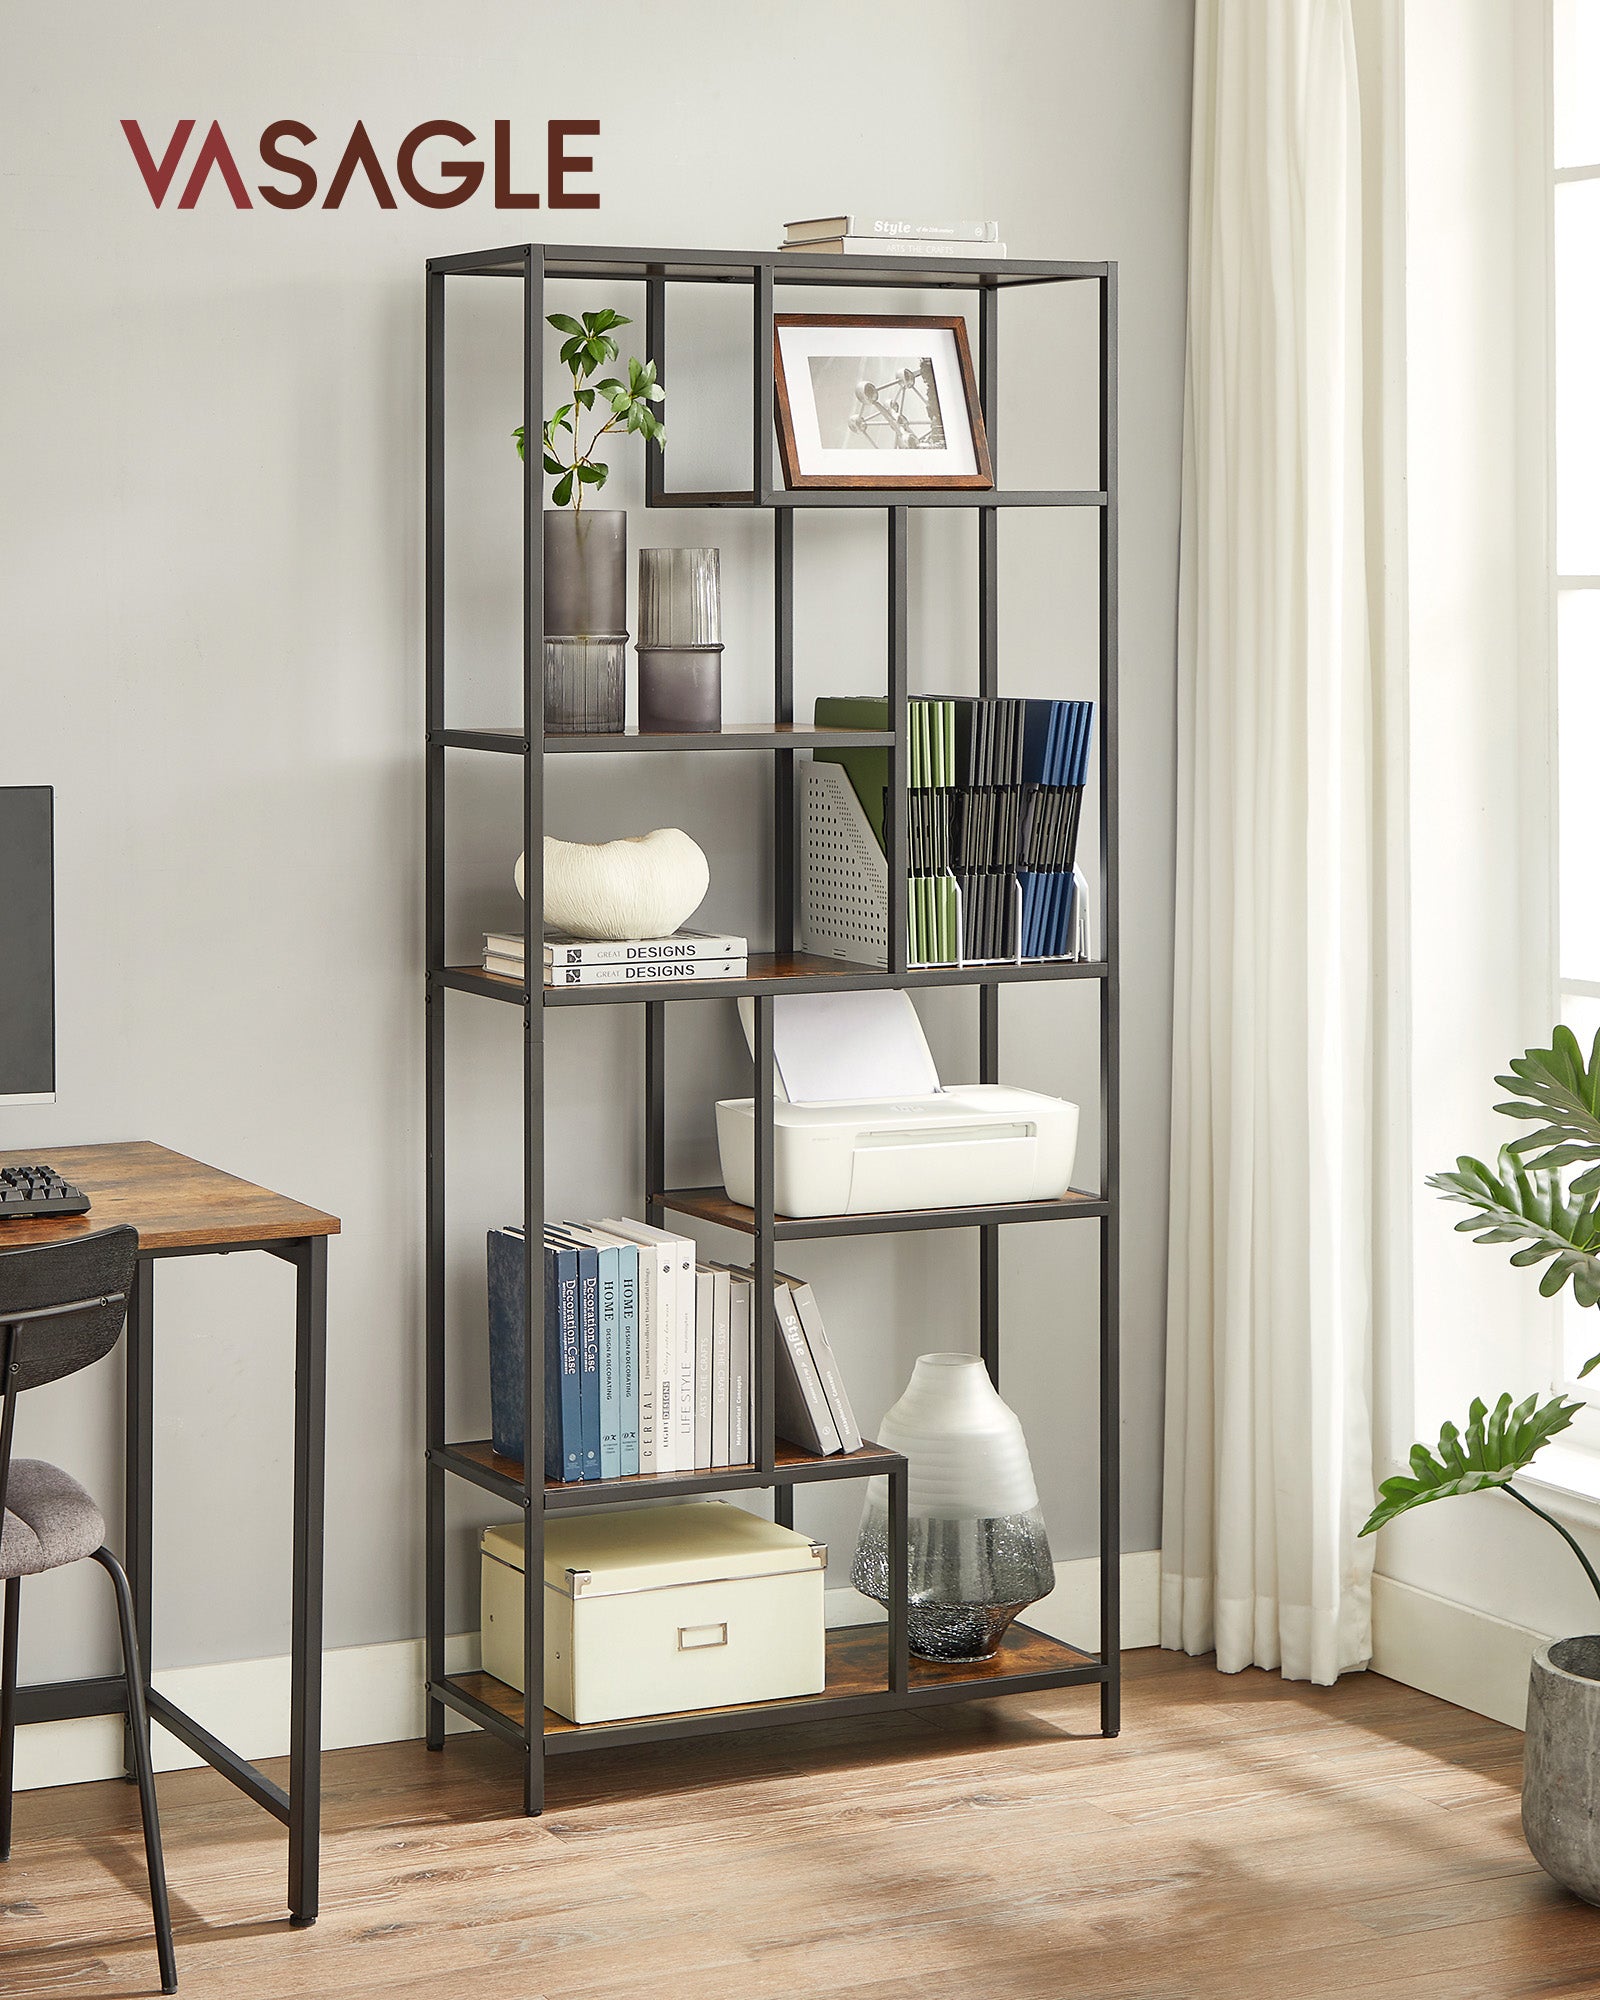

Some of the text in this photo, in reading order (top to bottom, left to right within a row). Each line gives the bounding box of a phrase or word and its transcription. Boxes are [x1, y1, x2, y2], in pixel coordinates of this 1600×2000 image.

[873, 220, 911, 235] Style
[886, 244, 954, 254] ARTS THE CRAFTS
[596, 964, 695, 979] GREAT DESIGNS
[597, 945, 696, 959] GREAT DESIGNS
[586, 1277, 597, 1343] Decoration
[604, 1281, 615, 1321] HOME
[623, 1279, 634, 1319] HOME
[566, 1280, 578, 1374] Decoration Case
[718, 1322, 726, 1345] ARTS
[784, 1314, 805, 1357] Style
[587, 1344, 598, 1373] Case
[699, 1337, 709, 1418] ARTS THE CRAFTS
[662, 1381, 670, 1420] DESIGNS
[643, 1391, 653, 1457] CEREAL
